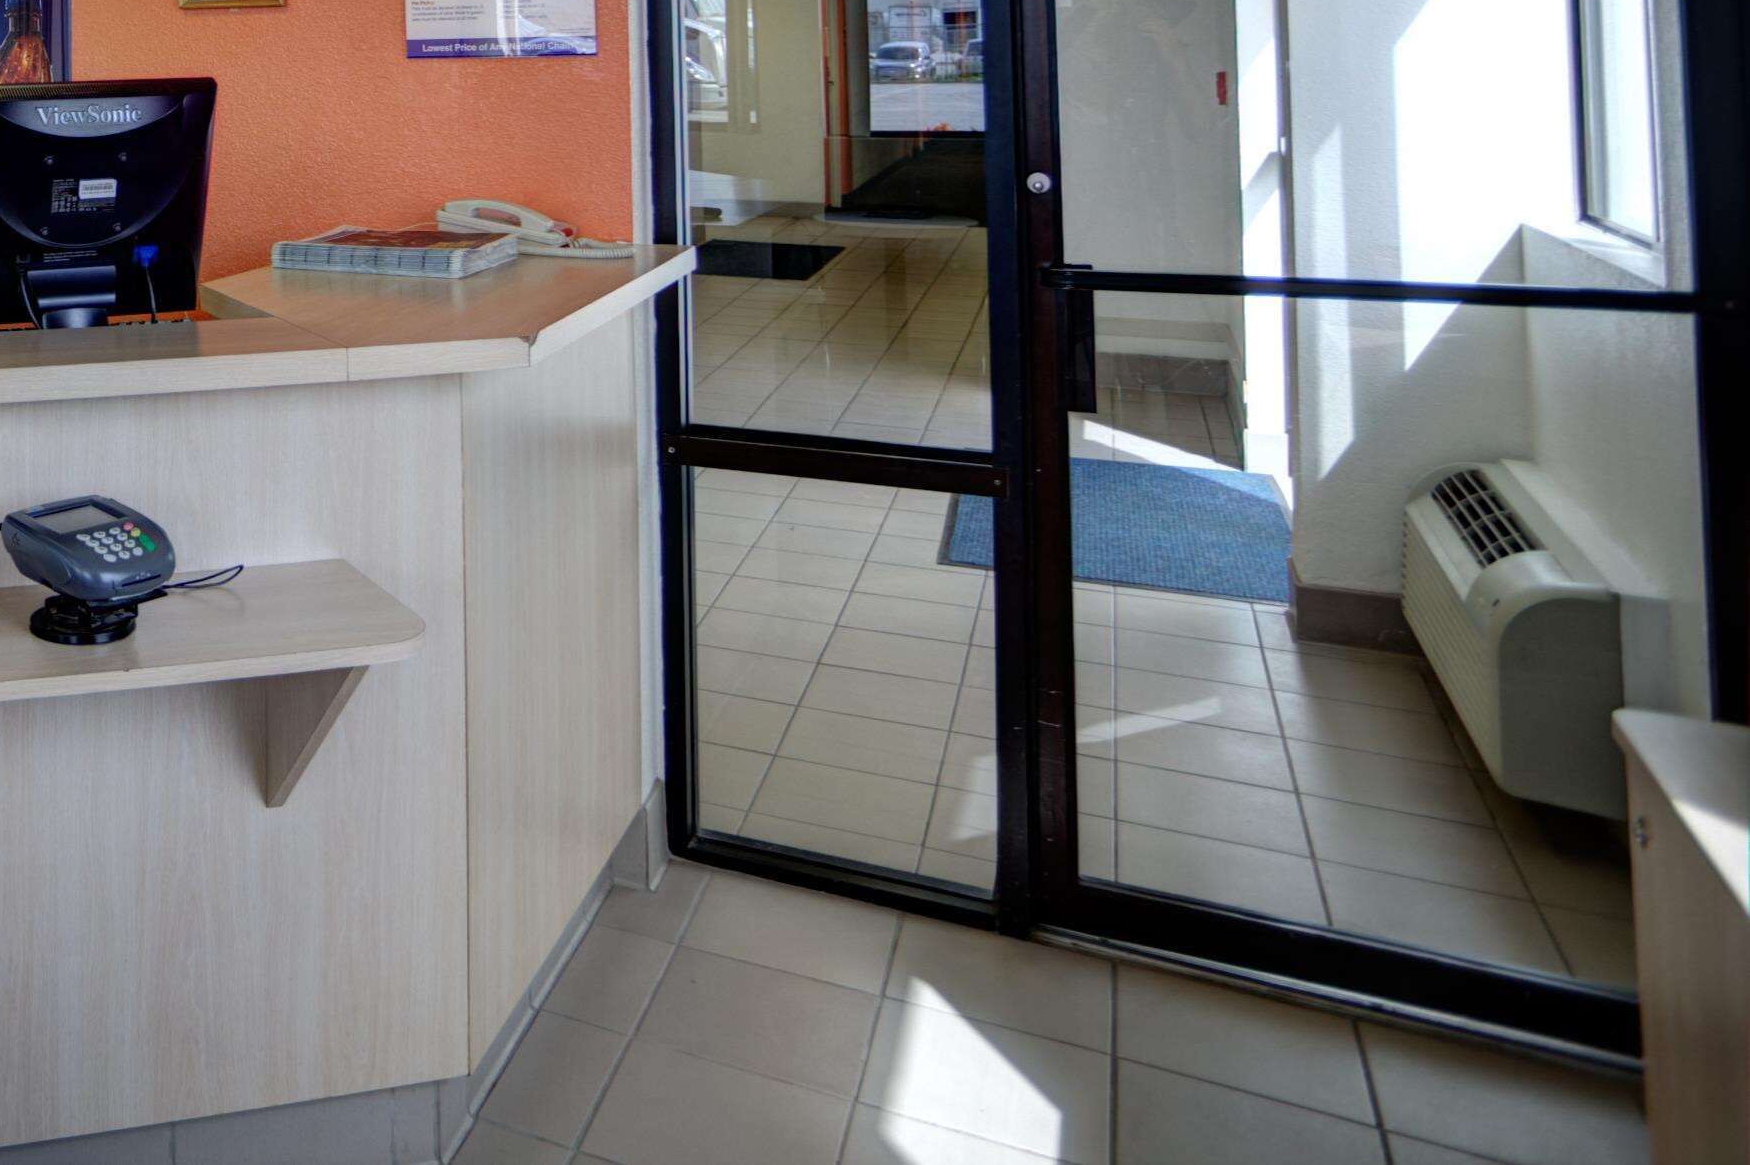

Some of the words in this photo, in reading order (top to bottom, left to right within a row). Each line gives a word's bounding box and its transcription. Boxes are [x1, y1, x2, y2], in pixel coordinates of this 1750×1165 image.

[422, 44, 453, 53] Lowest
[454, 43, 477, 52] Price
[478, 43, 488, 52] of
[37, 104, 142, 126] ViewSonic
